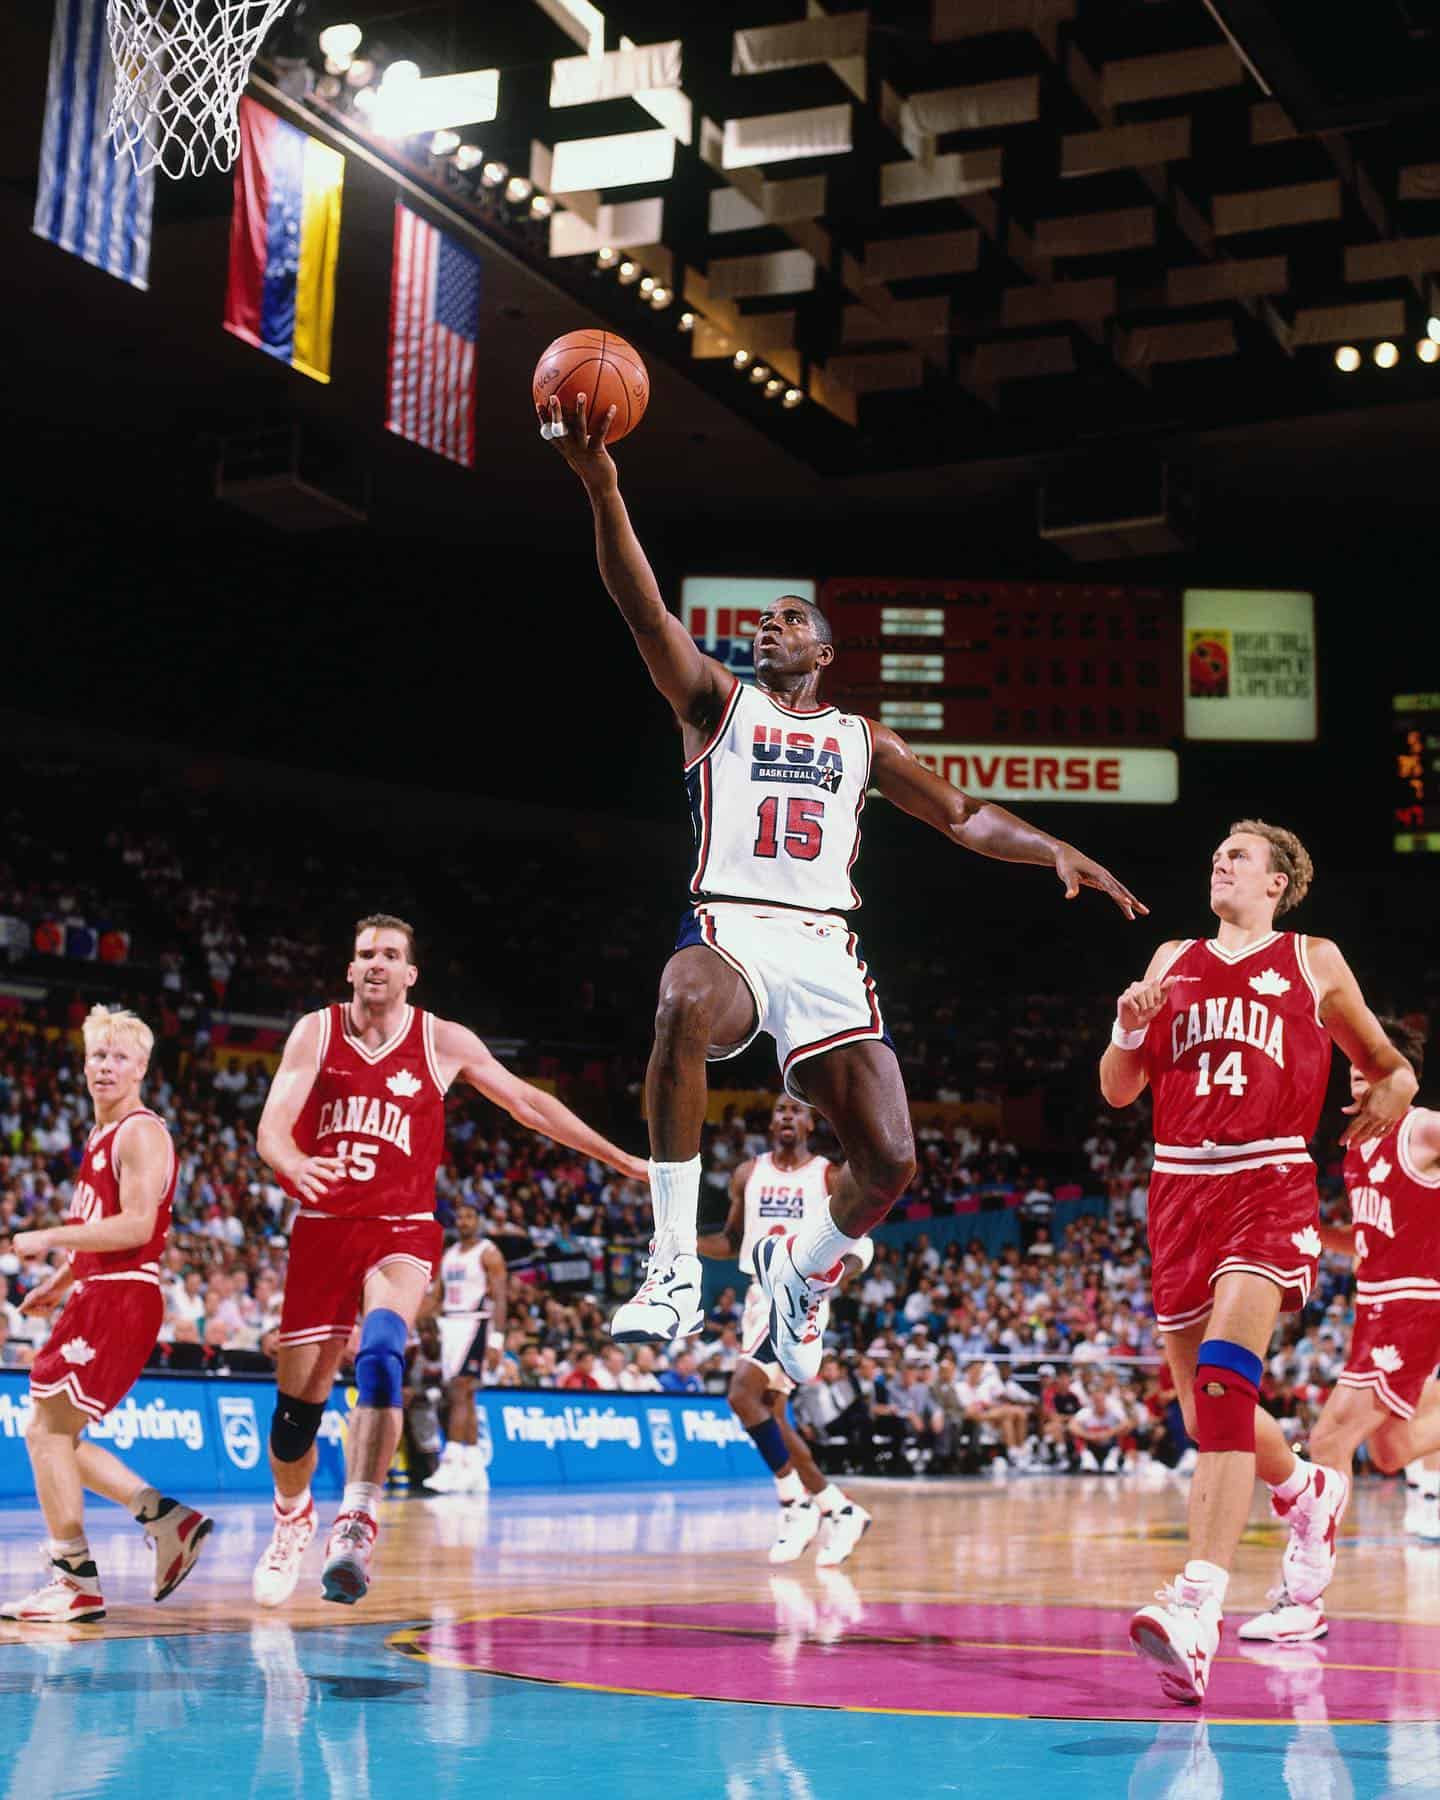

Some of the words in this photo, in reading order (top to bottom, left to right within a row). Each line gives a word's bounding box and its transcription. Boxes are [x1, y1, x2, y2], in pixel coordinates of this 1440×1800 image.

[691, 607, 761, 668] US
[752, 724, 843, 772] USA
[759, 768, 816, 780] BASKETBALL
[917, 754, 1120, 791] NVERSE
[753, 796, 825, 861] 15
[1171, 997, 1284, 1070] CANADA
[1195, 1051, 1248, 1096] 14
[316, 1096, 412, 1157] CANADA
[335, 1140, 379, 1182] 15
[759, 1187, 804, 1206] USA
[503, 1406, 566, 1449] Philips
[564, 1407, 641, 1449] Lighting
